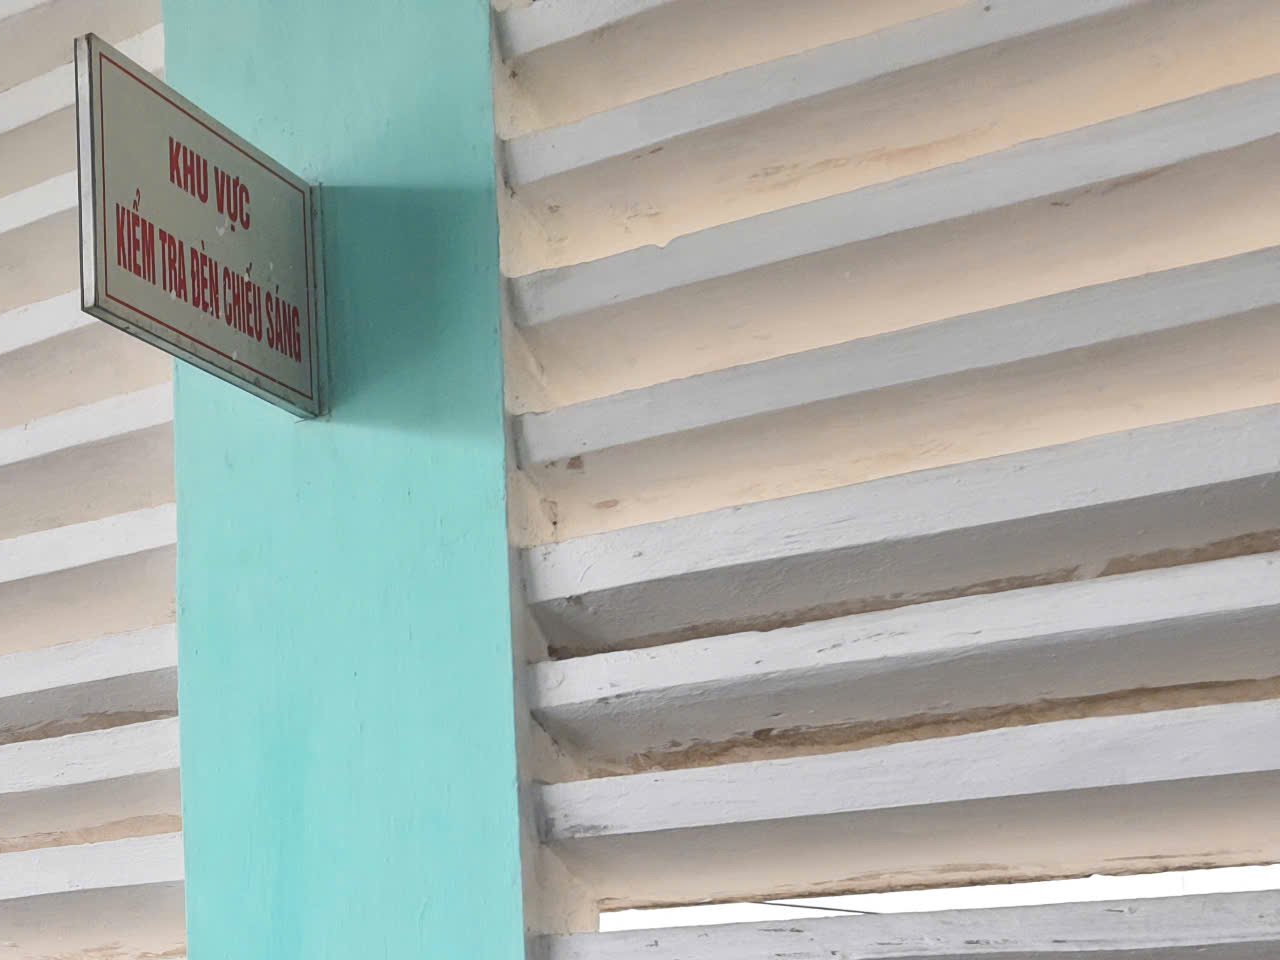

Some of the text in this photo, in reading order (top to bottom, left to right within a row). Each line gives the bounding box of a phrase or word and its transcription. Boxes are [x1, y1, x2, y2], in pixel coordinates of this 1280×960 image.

[169, 137, 251, 231] KHU VỰC
[116, 188, 302, 363] KIỂM TRA ĐÈN CHIẾU SÁNG
